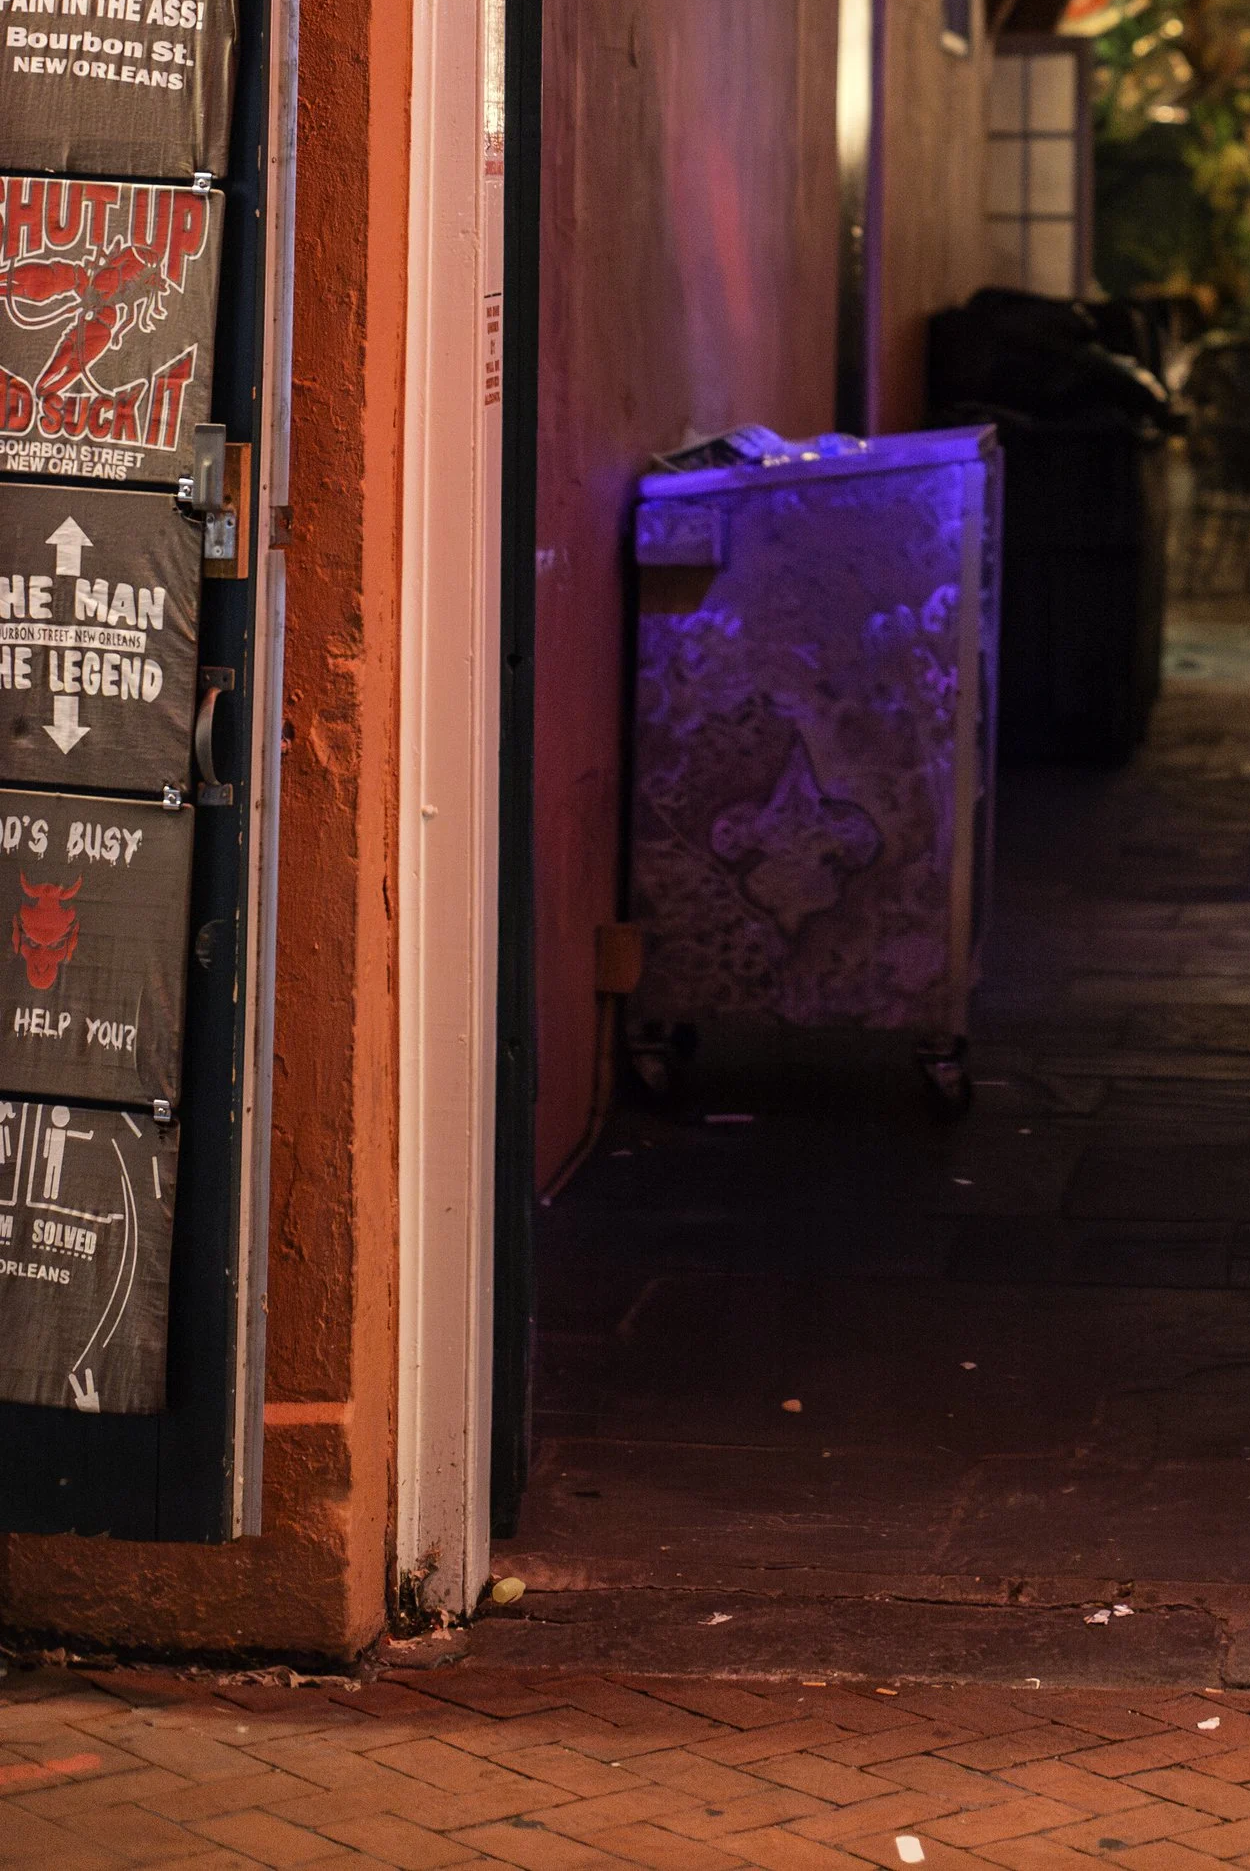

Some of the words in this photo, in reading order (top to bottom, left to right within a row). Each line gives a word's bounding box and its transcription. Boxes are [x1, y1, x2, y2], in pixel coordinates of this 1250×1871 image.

[6, 26, 143, 58] Bourbon
[151, 40, 194, 67] St.
[13, 56, 67, 74] NEW
[72, 60, 184, 90] ORLEANS
[0, 176, 122, 266] HUT
[129, 185, 211, 293] UP
[37, 379, 149, 447] SUCK
[6, 455, 46, 473] NEW
[48, 458, 127, 480] ORLEANS
[80, 445, 145, 468] STREET
[0, 575, 53, 620] HE
[74, 578, 166, 630] MAN
[75, 630, 96, 643] NEW
[99, 632, 141, 648] ORLEANS
[49, 649, 163, 703] LEGEND
[67, 821, 143, 868] BUSY
[14, 1007, 71, 1038] HELP
[86, 1017, 136, 1051] YOU?
[32, 1219, 97, 1255] SOLVED
[0, 1259, 71, 1285] ORLEANS
